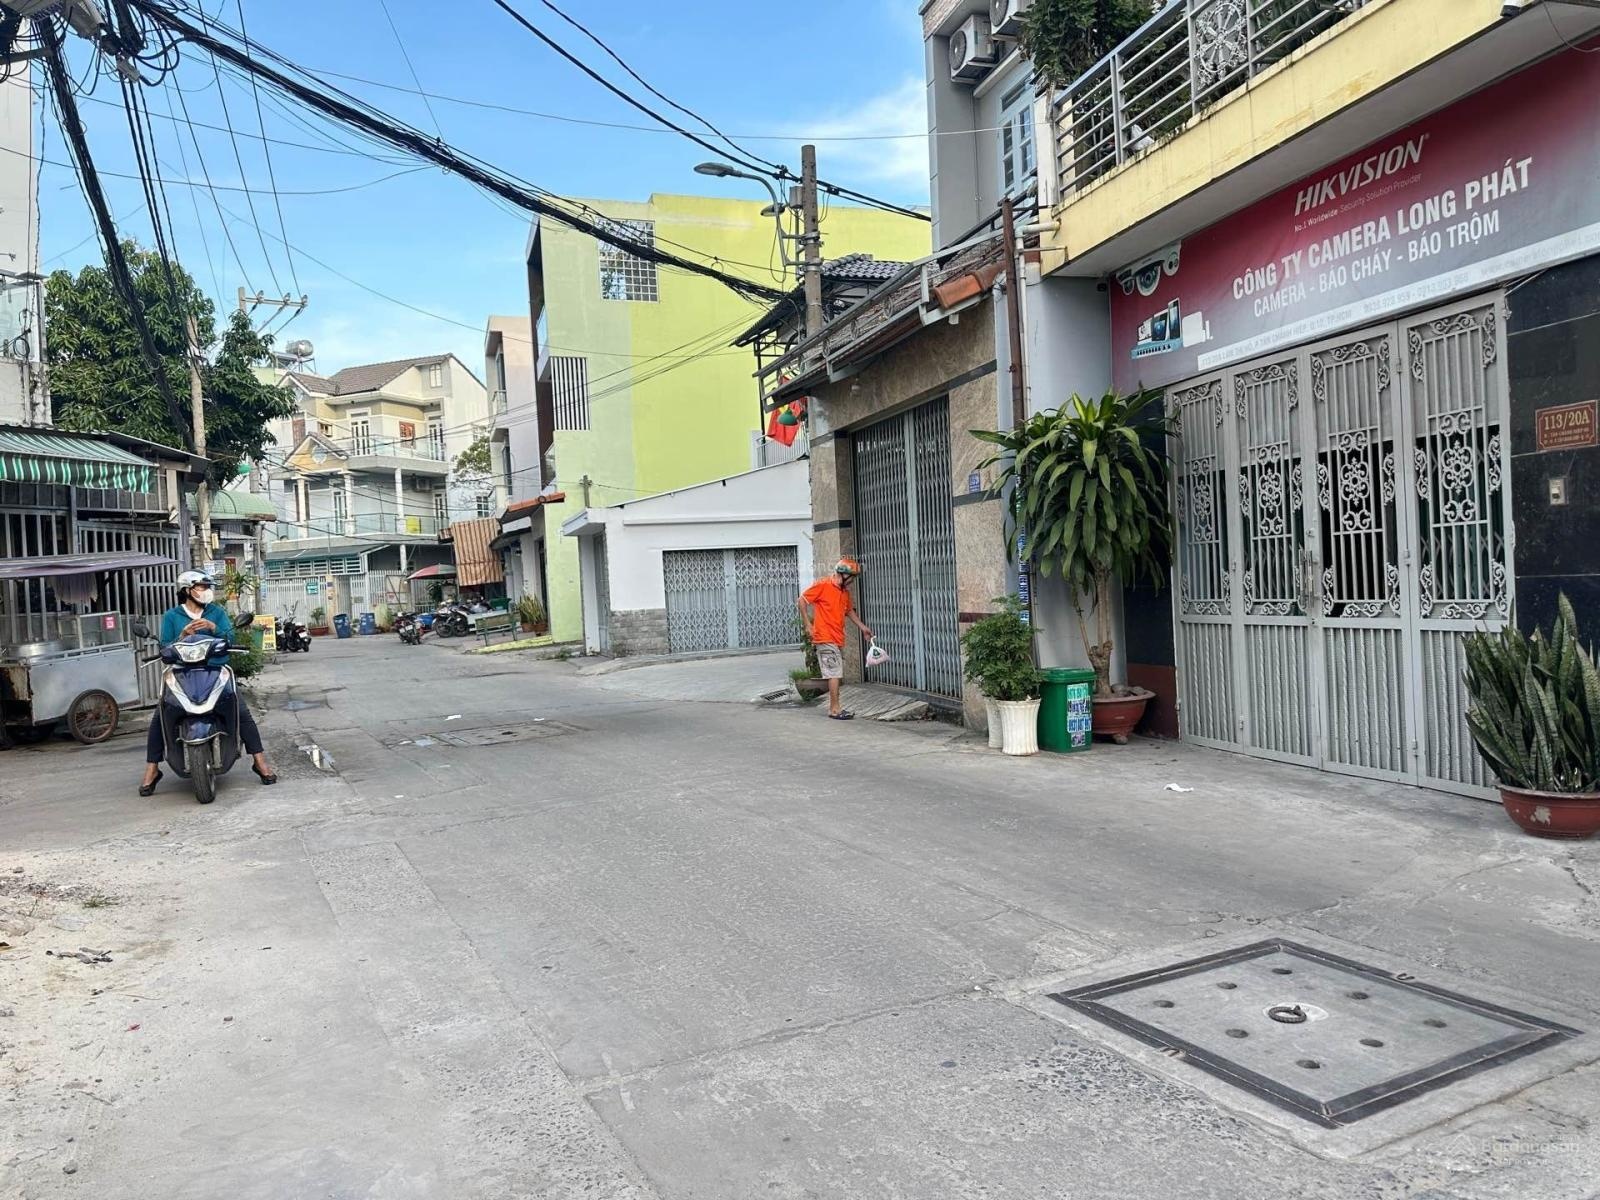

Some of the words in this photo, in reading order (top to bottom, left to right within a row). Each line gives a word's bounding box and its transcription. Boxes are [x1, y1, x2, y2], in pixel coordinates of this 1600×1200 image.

[1294, 135, 1425, 217] HIKVISION
[1308, 208, 1338, 225] Worldwide
[1366, 185, 1393, 201] Solution
[1394, 173, 1422, 190] Provider
[1233, 262, 1278, 300] CÔNG
[1281, 250, 1302, 280] TY
[1308, 215, 1391, 268] CAMERA
[1398, 190, 1457, 236] LONG
[1465, 156, 1533, 210] PHÁT
[1254, 283, 1307, 318] CAMERA
[1319, 264, 1347, 294] BÁO
[1351, 248, 1392, 282] CHÁY
[1408, 230, 1441, 262] BÁO
[1446, 209, 1500, 249] TRỘM
[1544, 409, 1590, 431] 113/20A
